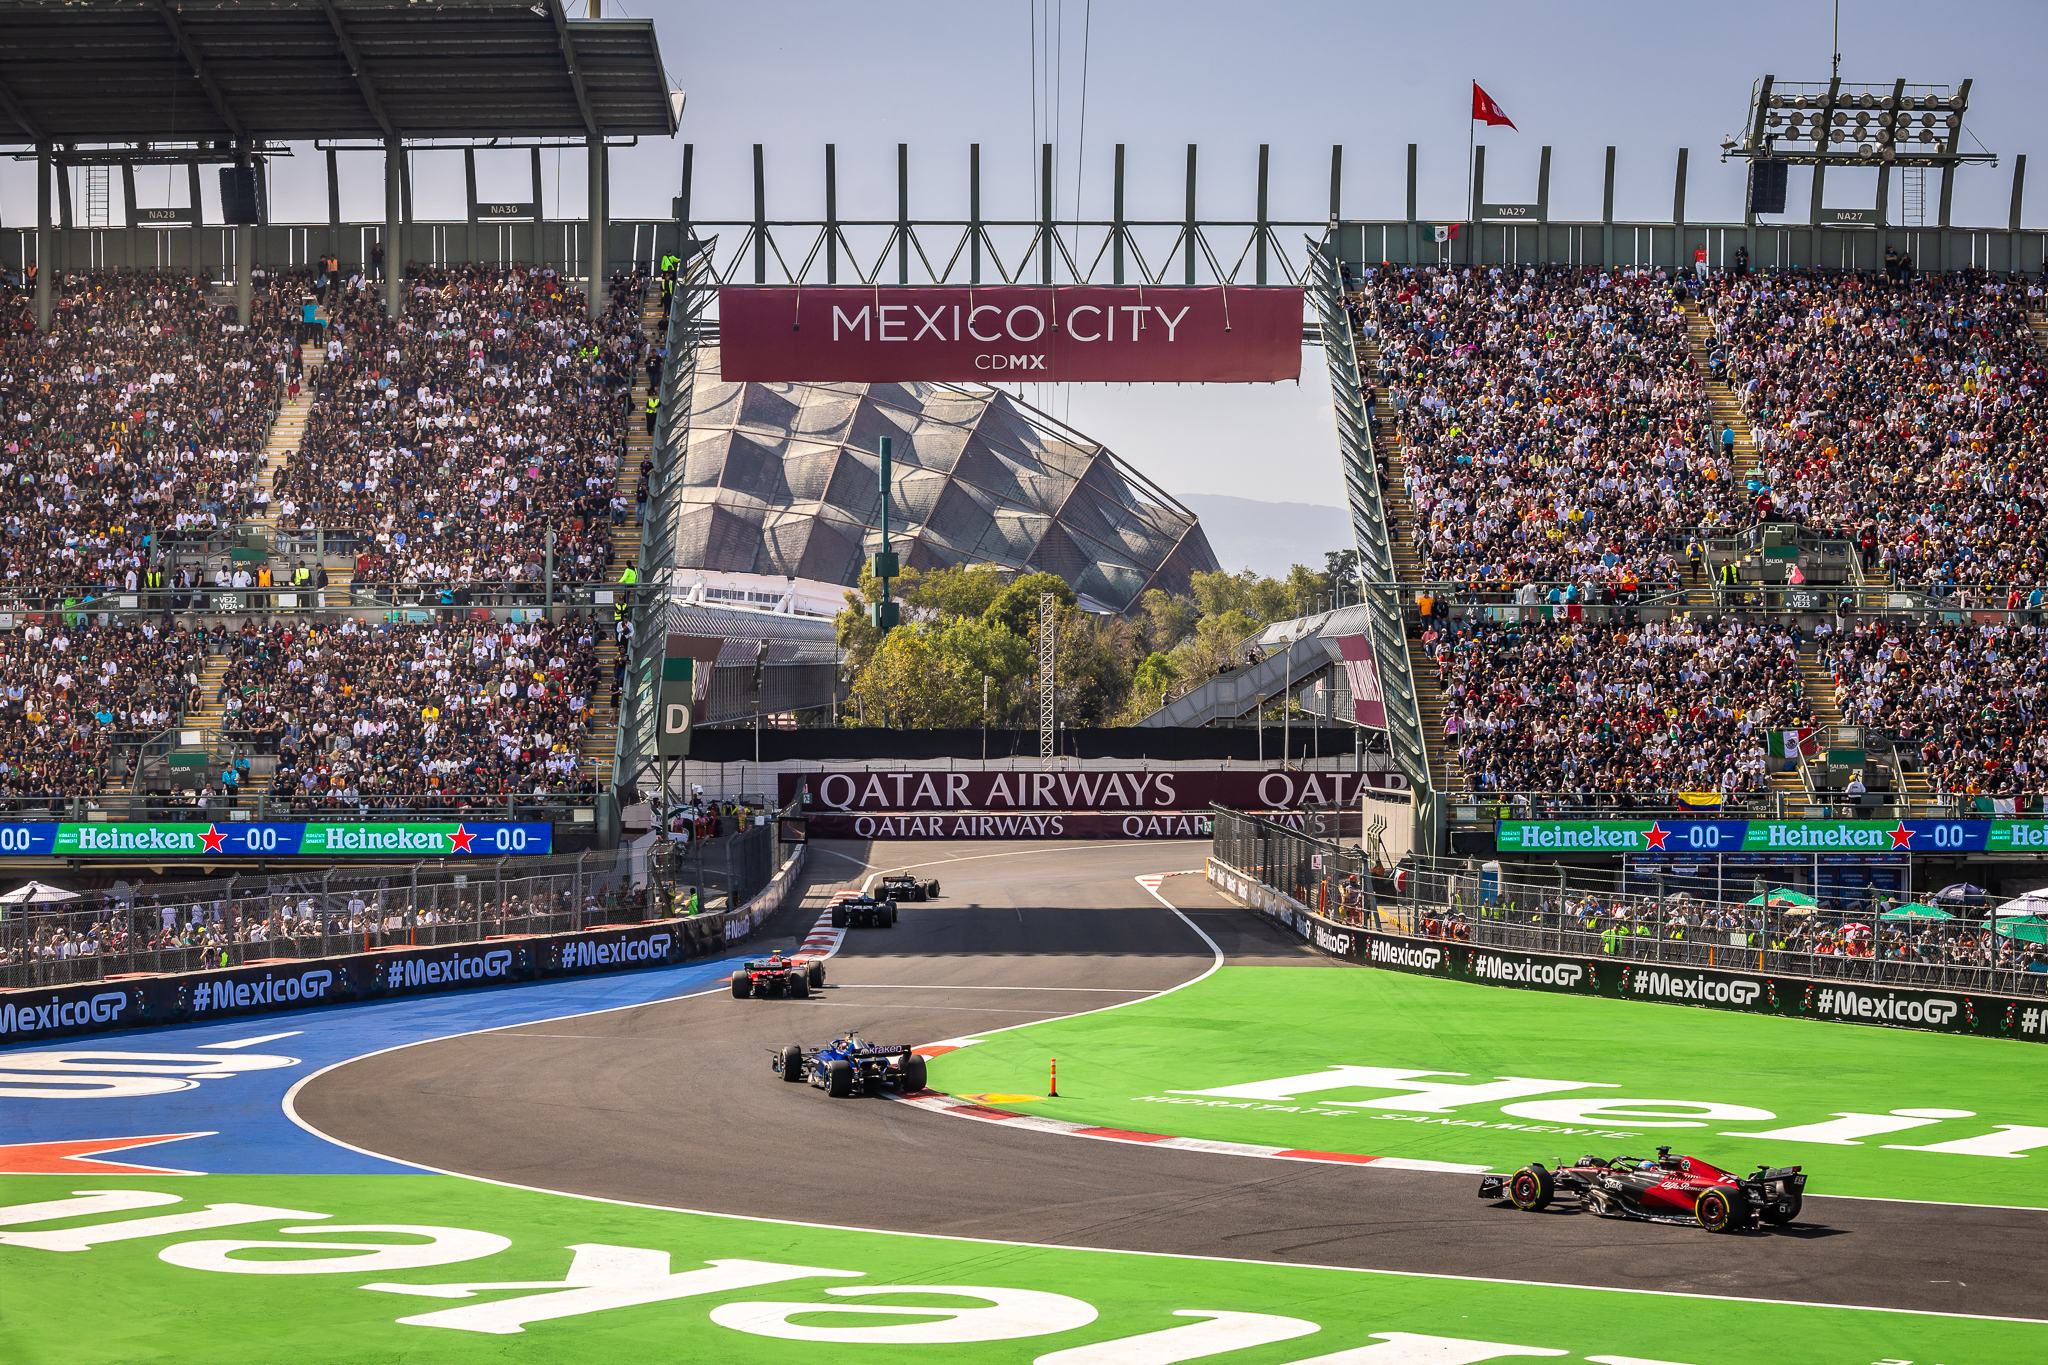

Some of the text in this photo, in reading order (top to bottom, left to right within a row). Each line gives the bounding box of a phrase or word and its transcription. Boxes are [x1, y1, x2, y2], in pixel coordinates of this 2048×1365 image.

[148, 210, 176, 219] NA28
[491, 205, 518, 214] NA30
[1499, 207, 1526, 216] NA29
[1837, 212, 1863, 220] NA27
[832, 304, 1190, 342] MEXICO CITY
[974, 354, 1046, 370] CDMX
[219, 596, 237, 604] VE22
[1792, 594, 1811, 602] VE21
[665, 703, 690, 734] D
[819, 772, 1177, 811] QATAR AIRWAYS
[1, 827, 31, 851] 0.0
[78, 827, 277, 851] Heineken 0.0
[325, 827, 527, 851] Heineken 0.0
[854, 815, 1064, 839] QATAR AIRWAYS
[1122, 815, 1211, 839] QATAR
[1521, 825, 1720, 849] Heineken 0.0
[1768, 824, 1964, 848] Heineken 0.0
[2010, 824, 2048, 846] Hei
[562, 933, 671, 969] #MexicoGP
[1316, 925, 1350, 955] #MexicoGP
[1371, 939, 1441, 970] #MexicoGP
[388, 950, 512, 988] #MexicoGP
[1475, 954, 1582, 987] #MexicoGP
[193, 969, 332, 1012] #MexicoGP
[1633, 971, 1760, 1005] #MexicoGP
[1817, 988, 1957, 1024] #MexicoGP
[869, 1044, 902, 1054] kraken
[1369, 1113, 1644, 1139] SANAMENTE
[1604, 1177, 1623, 1192] Stake
[1661, 1181, 1679, 1191] Alfa
